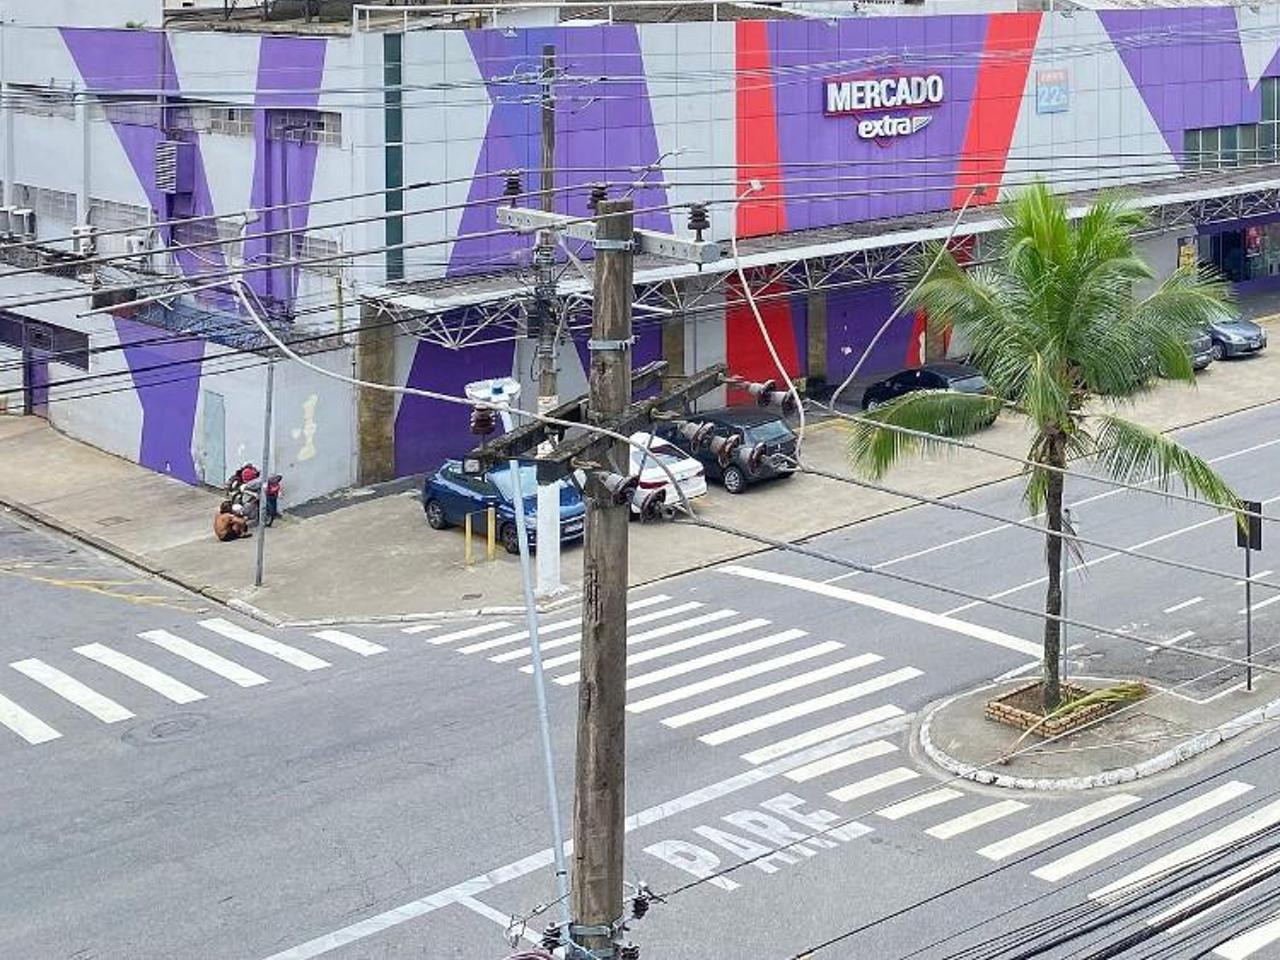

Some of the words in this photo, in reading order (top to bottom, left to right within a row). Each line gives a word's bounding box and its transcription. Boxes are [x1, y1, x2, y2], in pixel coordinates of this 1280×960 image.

[828, 75, 943, 112] MERCADO
[857, 115, 912, 139] extra
[641, 792, 875, 892] PARE
